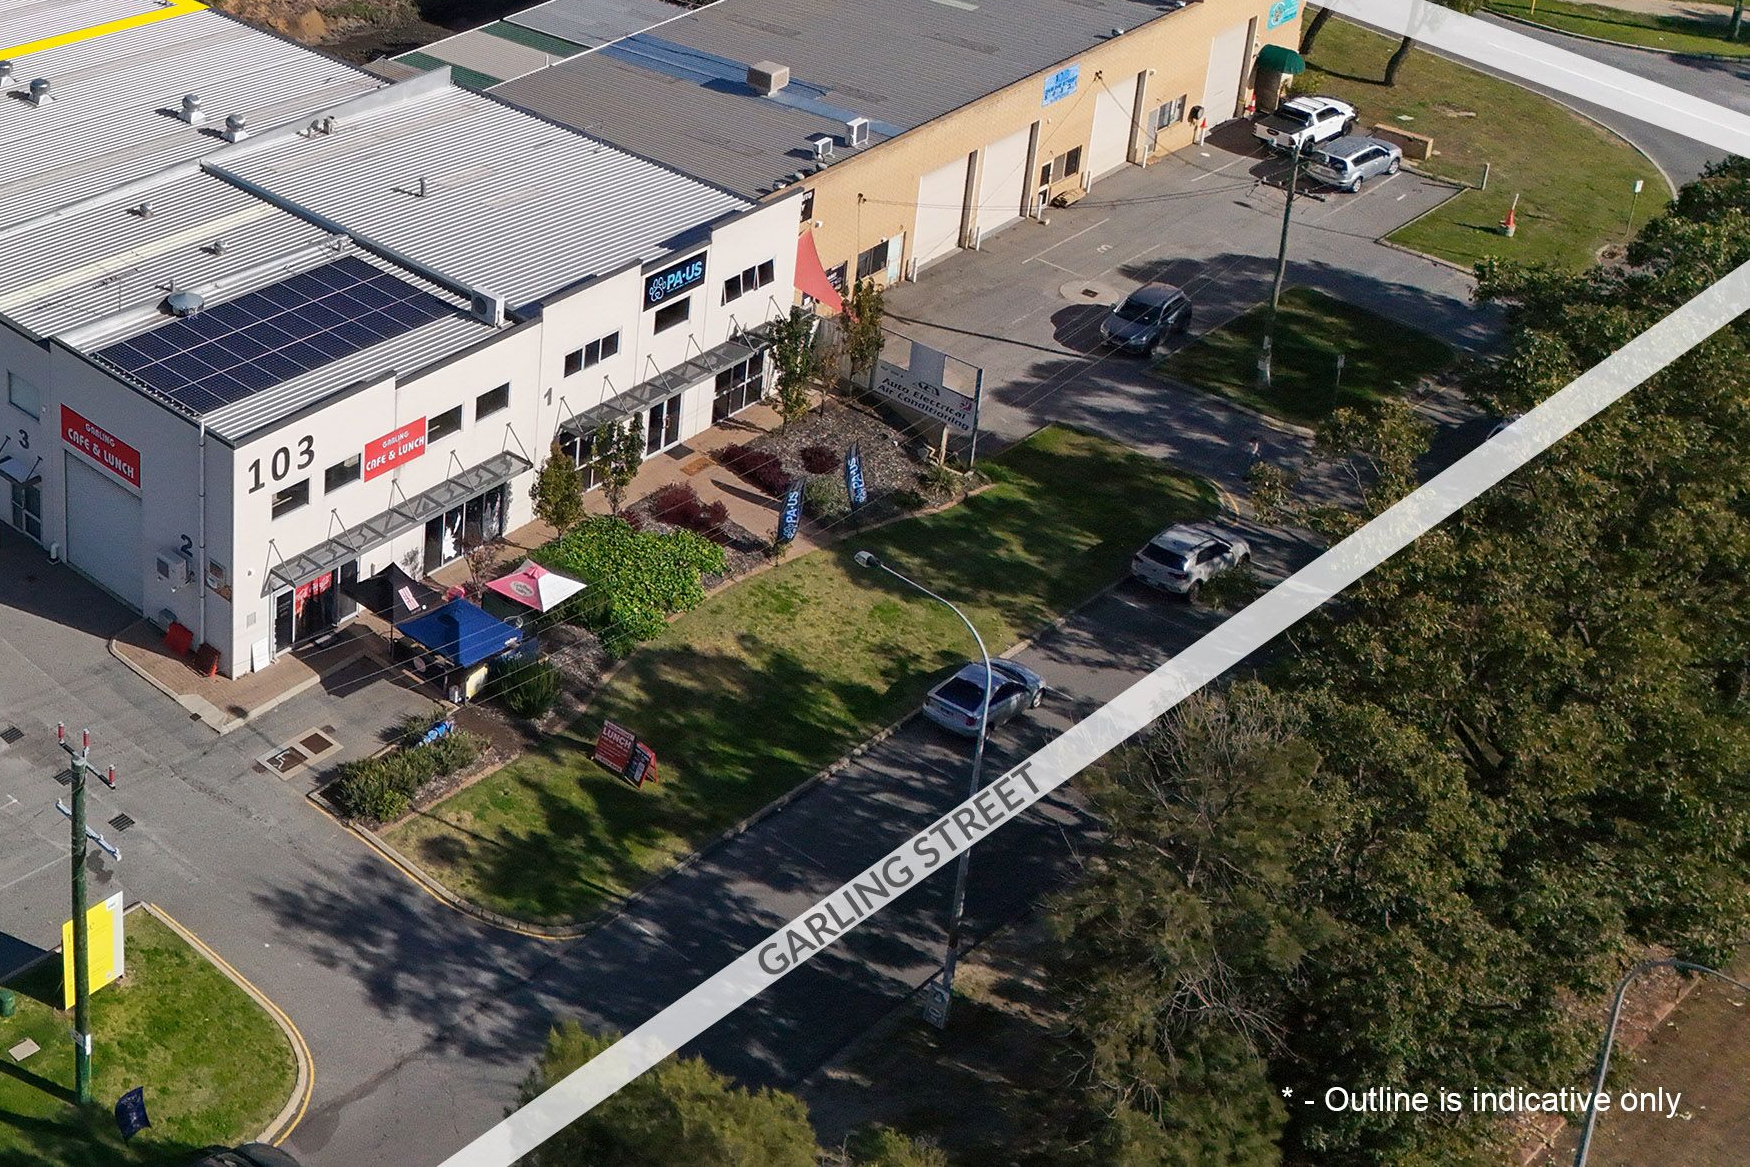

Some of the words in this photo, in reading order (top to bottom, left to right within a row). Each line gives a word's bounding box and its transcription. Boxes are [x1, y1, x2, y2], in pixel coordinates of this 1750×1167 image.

[544, 387, 552, 406] 1
[878, 384, 894, 395] Air
[898, 392, 970, 431] Conditioning
[881, 378, 909, 394] Auto
[913, 391, 966, 420] Electrical
[18, 429, 29, 449] 3
[85, 423, 116, 448] GARLING
[382, 430, 410, 448] GARLING
[67, 428, 90, 450] CAFE
[92, 442, 102, 458] &
[104, 450, 134, 479] LUNCH
[248, 434, 316, 495] 103
[366, 453, 386, 472] CAFE
[388, 450, 396, 460] &
[398, 435, 425, 456] LUNCH
[180, 534, 194, 558] 2
[602, 726, 632, 749] LUNCH
